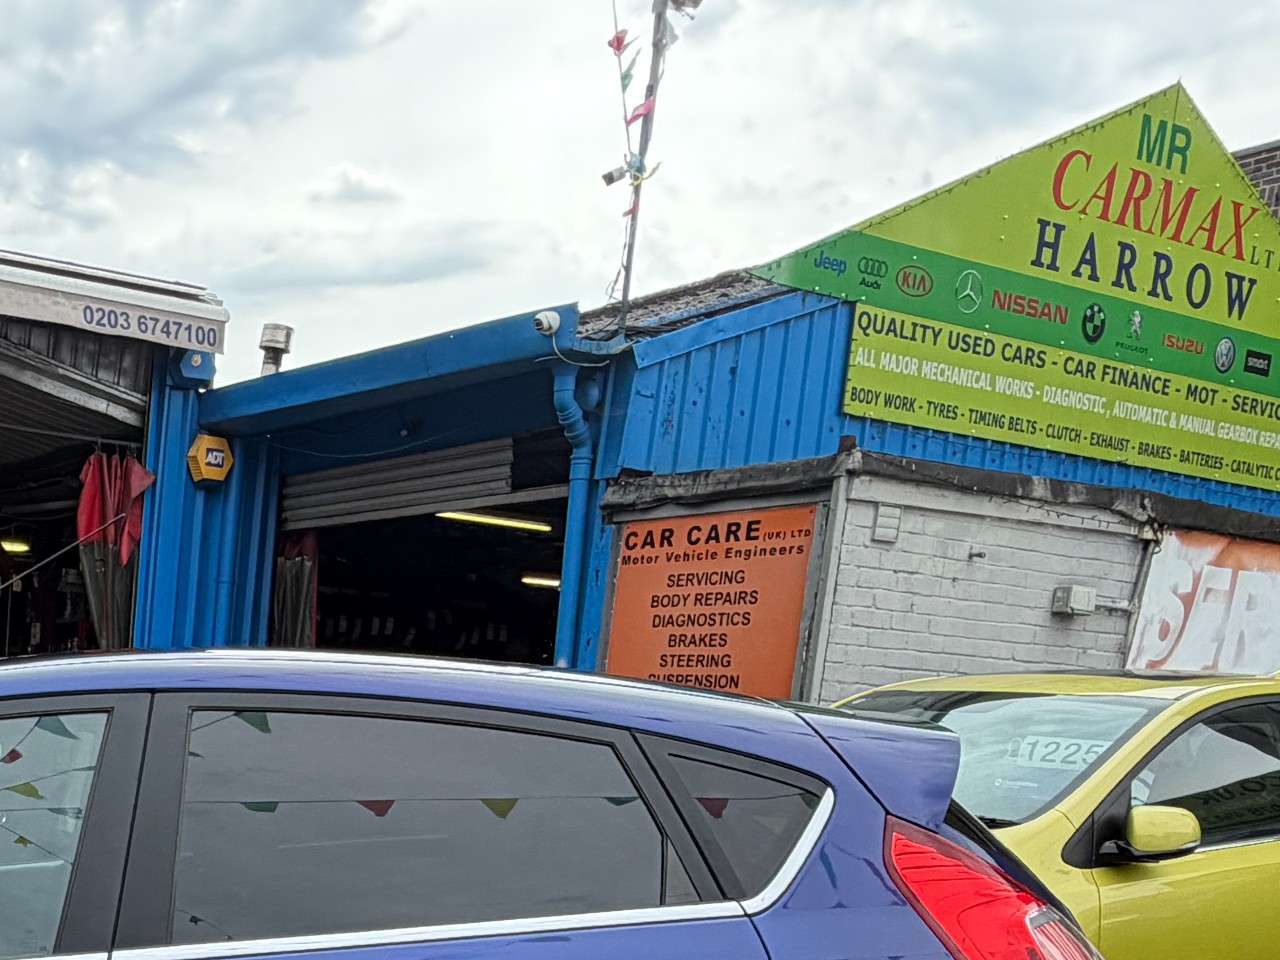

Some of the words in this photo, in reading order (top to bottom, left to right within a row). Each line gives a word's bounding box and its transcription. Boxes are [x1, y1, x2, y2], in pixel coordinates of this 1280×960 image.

[1136, 113, 1192, 175] MR
[1051, 149, 1261, 262] CARMAX
[1249, 245, 1280, 272] LT
[814, 250, 847, 277] Jeep
[1030, 218, 1258, 322] HARROW
[858, 277, 881, 290] Audi
[901, 270, 927, 292] KIA
[991, 289, 1069, 325] NISSAN
[83, 305, 131, 330] 0203
[137, 314, 217, 347] 6747100
[1161, 334, 1205, 355] ISUZU
[857, 310, 944, 346] QUALITY
[947, 330, 996, 358] USED
[1001, 342, 1047, 369] CARS
[1063, 356, 1097, 381] CAR
[1101, 364, 1171, 397] FINANCE
[1185, 383, 1219, 406] MOT
[856, 347, 876, 368] ALL
[880, 352, 919, 377] MAJOR
[922, 360, 992, 391] MECHANICAL
[995, 375, 1035, 399] WORKS
[1112, 400, 1169, 427] AUTOMATIC
[1179, 413, 1216, 437] MANUAL
[1217, 422, 1259, 445] GEARBOX
[850, 386, 881, 406] BODY
[884, 392, 916, 413] WORK
[926, 400, 959, 421] TYRES
[969, 408, 1006, 430] TIMING
[1007, 416, 1038, 435] BELTS
[1045, 423, 1082, 444] CLUTCH
[1089, 431, 1131, 453] EXHAUST
[1137, 441, 1172, 460] BRAKES
[1179, 449, 1224, 470] BATTERIES
[1230, 459, 1274, 480] CATALYTIC
[206, 450, 225, 465] ADT
[624, 528, 675, 551] CAR
[686, 519, 762, 546] CARE
[762, 531, 786, 543] (UK)
[790, 529, 812, 539] LTD
[621, 554, 660, 566] Motor
[665, 549, 718, 563] Vehicle
[724, 544, 805, 561] Engineers
[666, 569, 746, 589] SERVICING
[650, 593, 690, 609] BODY
[693, 589, 759, 608] REPAIRS
[651, 611, 751, 629] DIAGNOSTICS
[667, 632, 728, 648] BRAKES
[659, 653, 732, 668] STEERING
